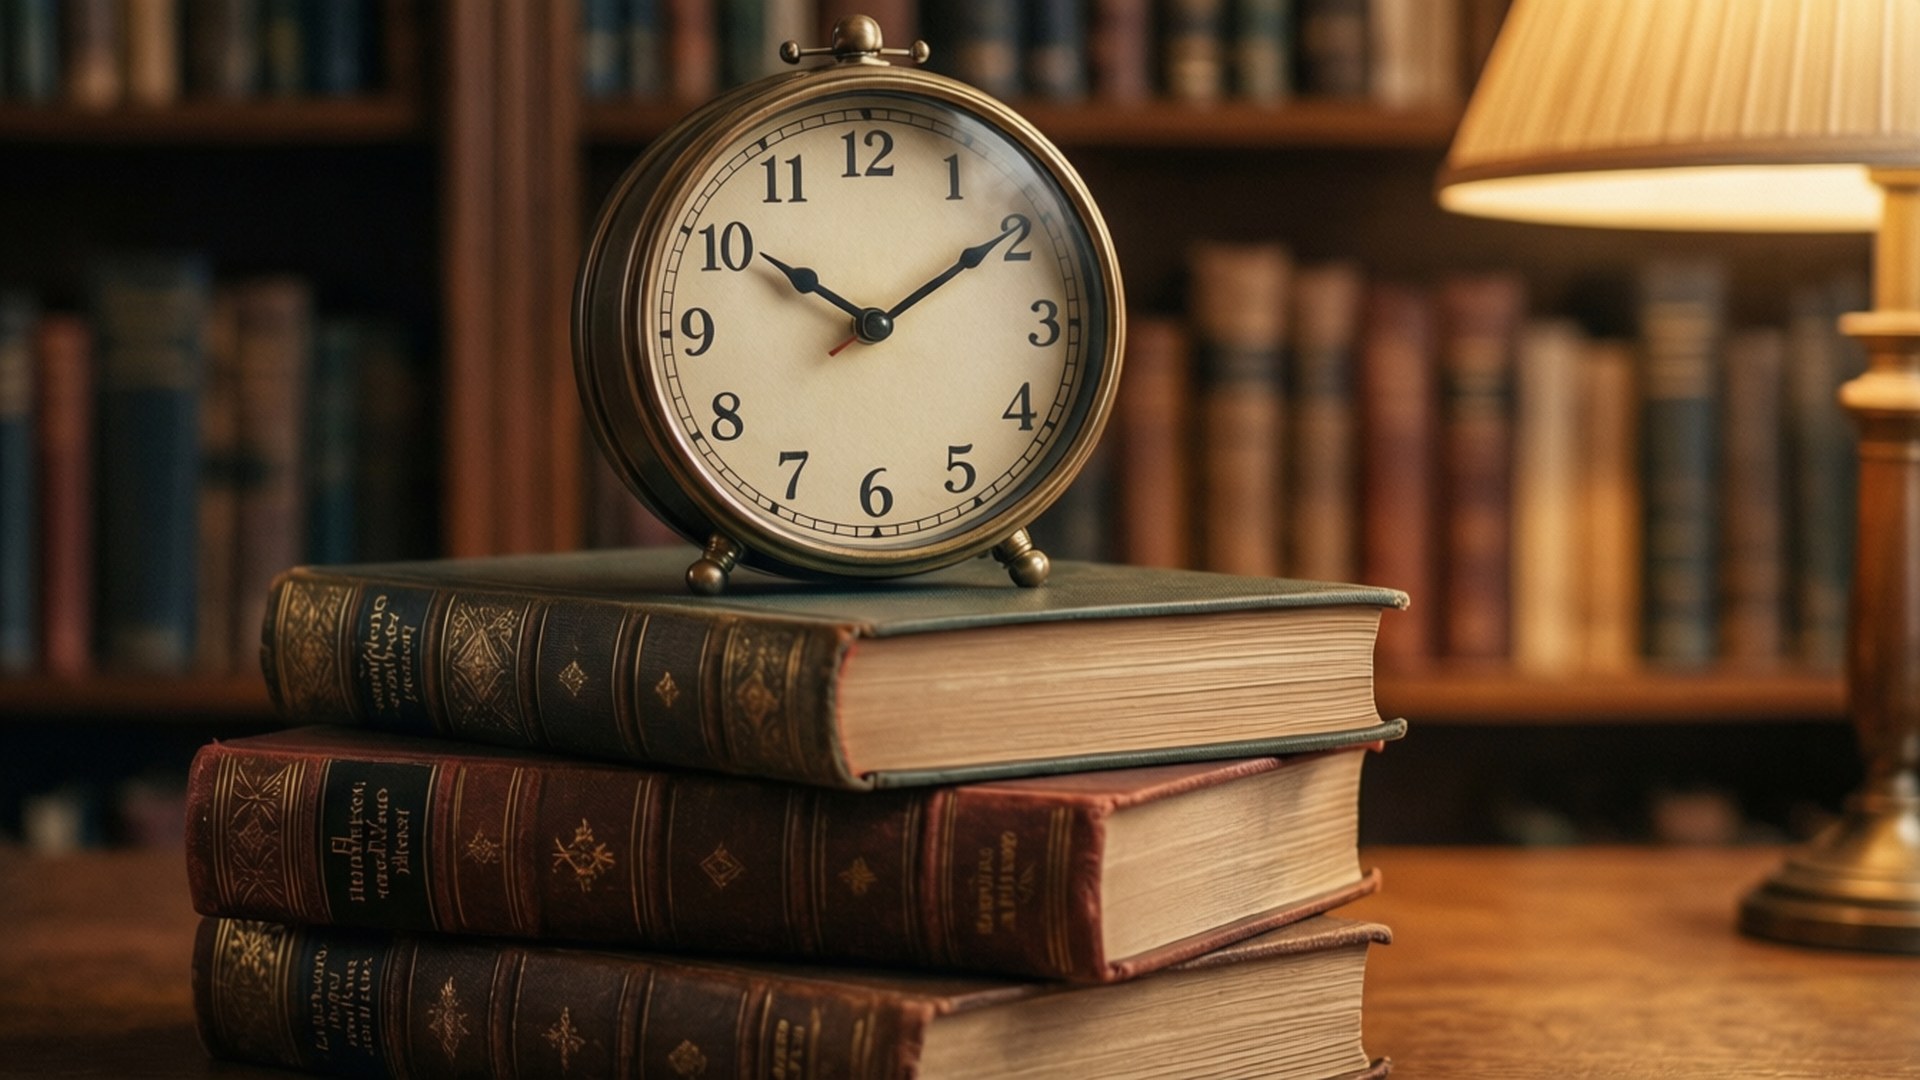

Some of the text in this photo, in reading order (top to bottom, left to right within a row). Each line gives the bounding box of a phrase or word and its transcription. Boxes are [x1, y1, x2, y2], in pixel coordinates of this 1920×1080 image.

[760, 153, 809, 204] 11
[840, 129, 896, 178] 12
[943, 152, 964, 201] 1
[698, 221, 754, 272] 10
[1000, 213, 1033, 262] 2
[680, 307, 715, 357] 9
[1028, 299, 1061, 348] 3
[711, 391, 744, 442] 8
[1001, 381, 1038, 432] 4
[778, 450, 809, 500] 7
[859, 467, 894, 518] 6
[944, 443, 977, 494] 5
